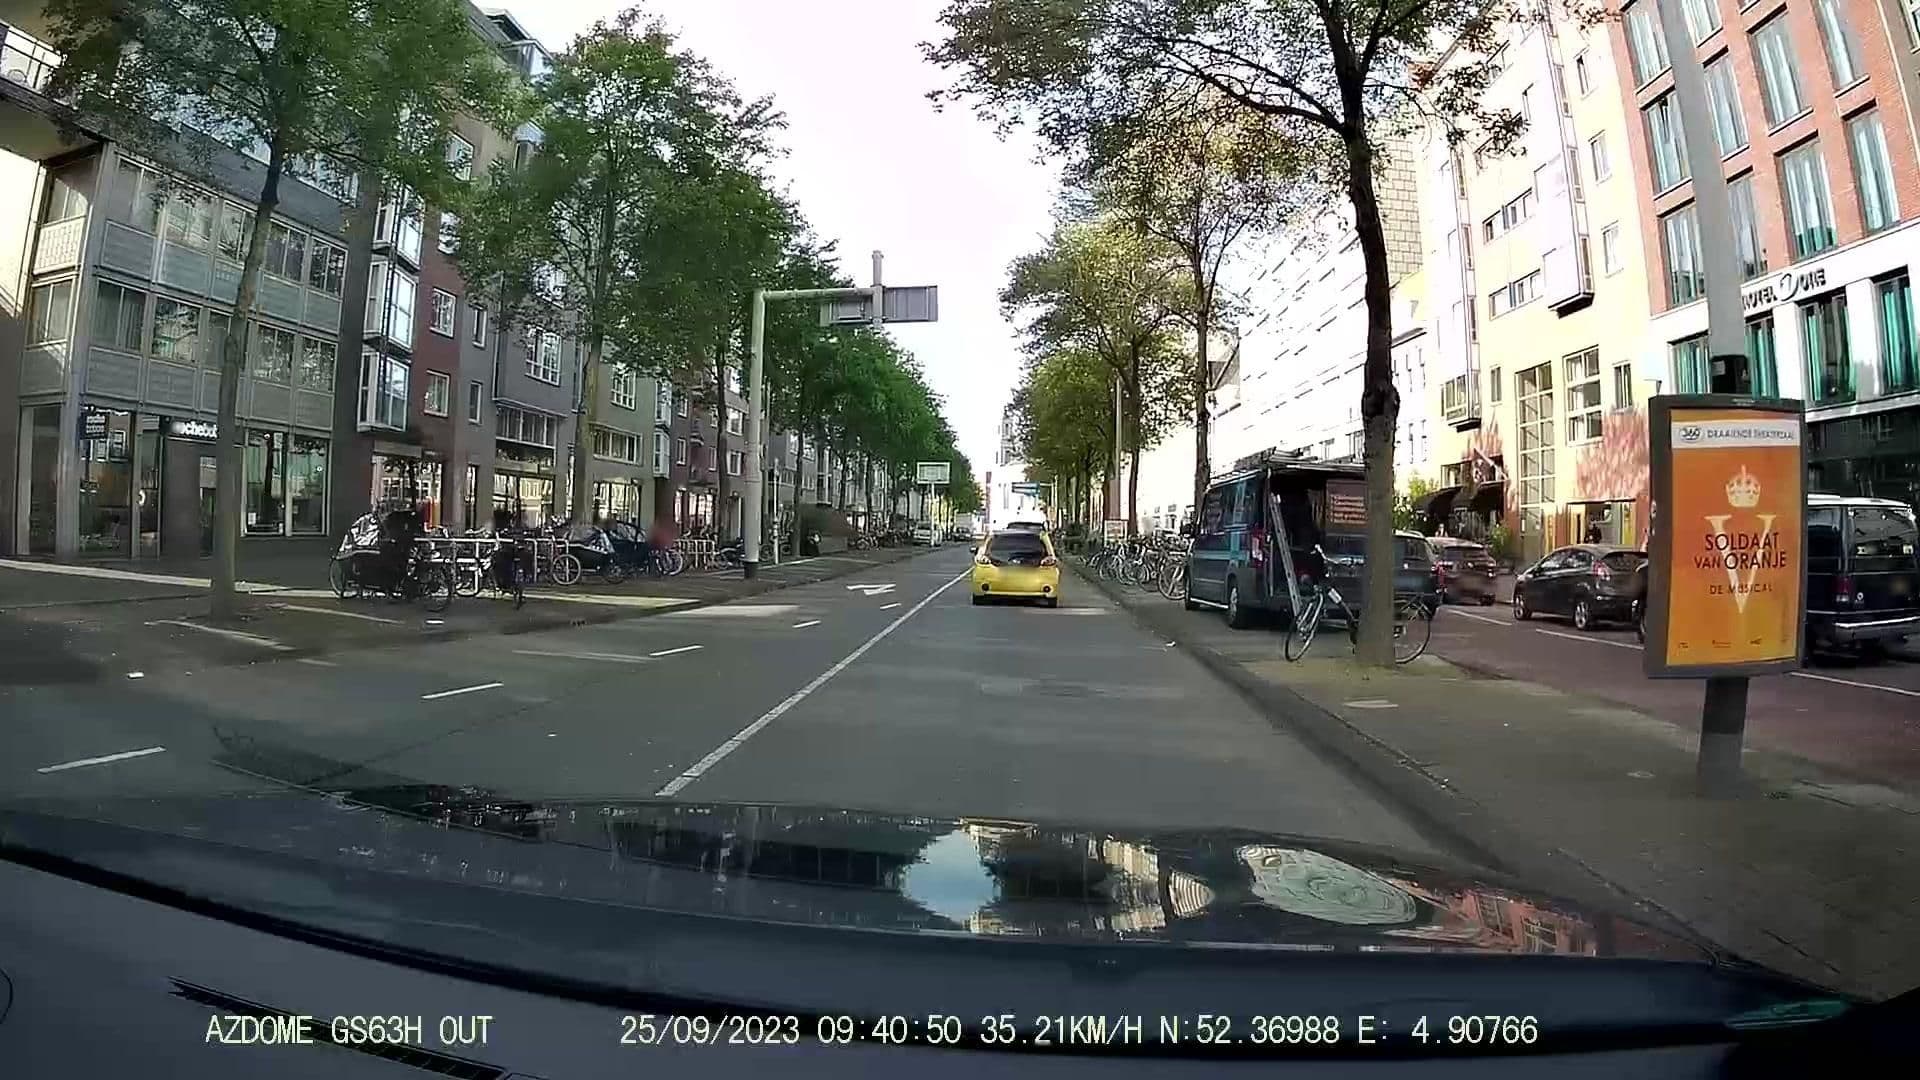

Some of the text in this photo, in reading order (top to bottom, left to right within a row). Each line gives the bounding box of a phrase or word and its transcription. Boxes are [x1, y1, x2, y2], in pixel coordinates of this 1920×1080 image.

[1705, 532, 1779, 551] SOLDAAT
[1694, 551, 1787, 570] VAN ORANJE
[1709, 583, 1773, 595] DE MUSICAL
